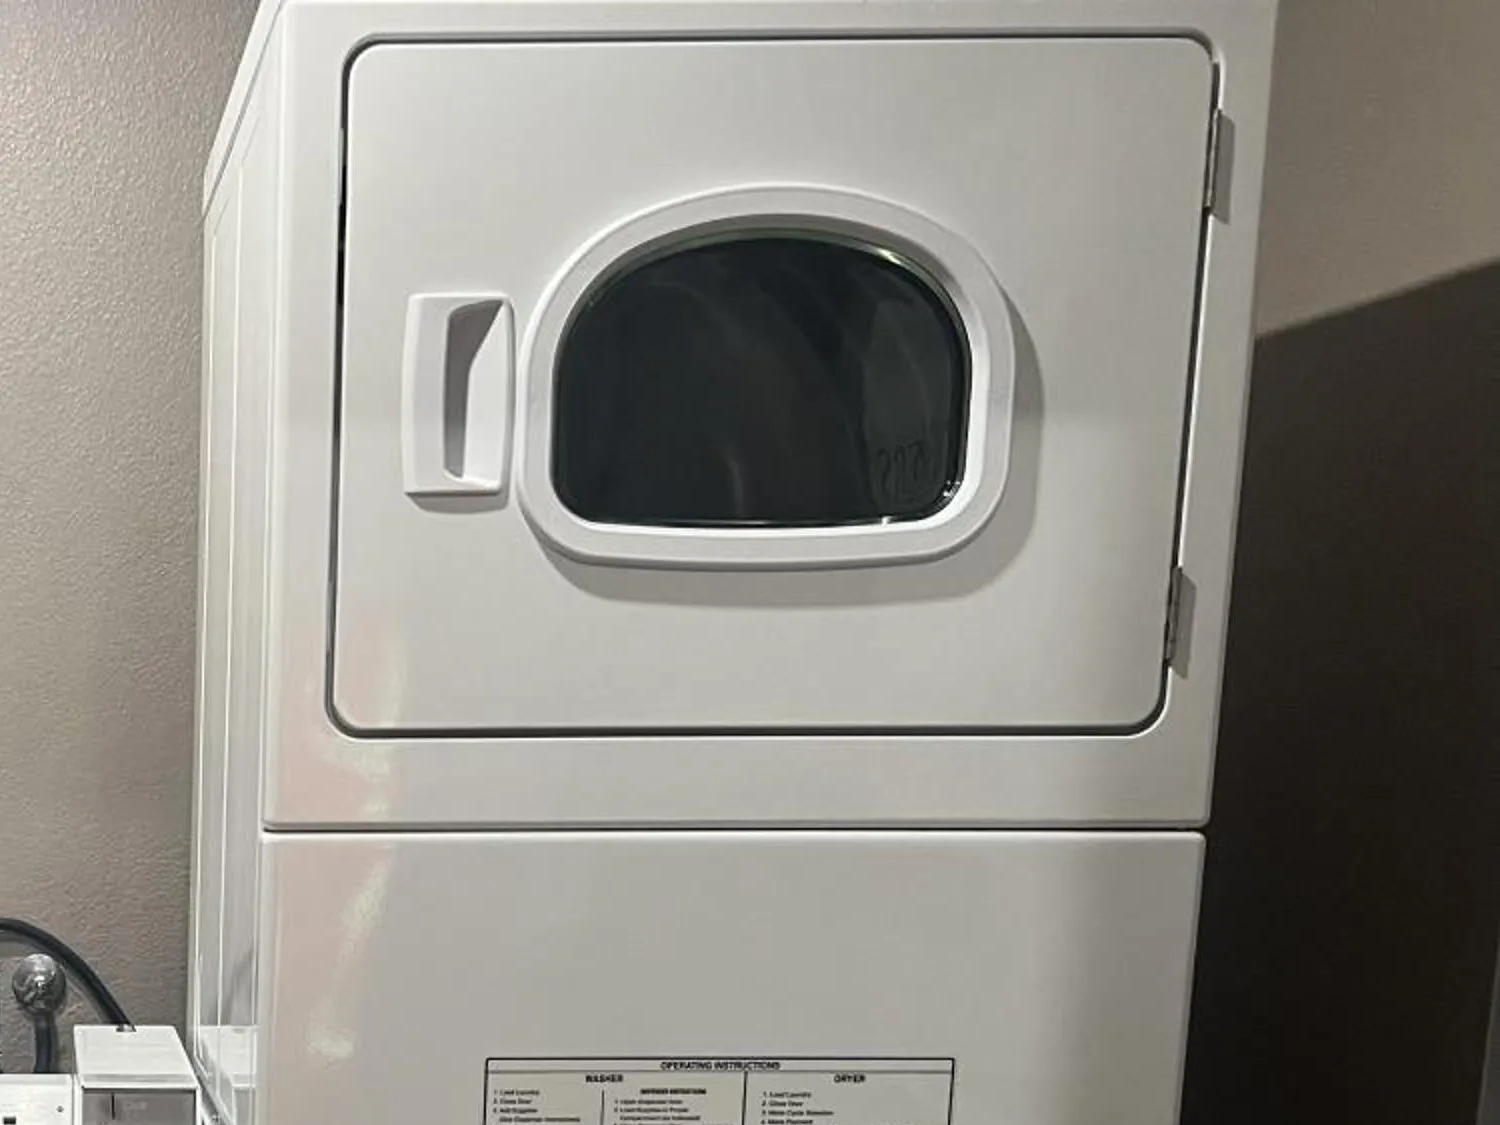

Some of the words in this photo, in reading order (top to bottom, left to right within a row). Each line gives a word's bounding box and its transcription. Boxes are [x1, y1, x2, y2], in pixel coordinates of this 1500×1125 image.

[660, 1061, 712, 1071] OPERATING
[714, 1061, 781, 1071] INSTRUCTIONS
[585, 1074, 623, 1083] WASHER
[833, 1074, 866, 1083] DRYER
